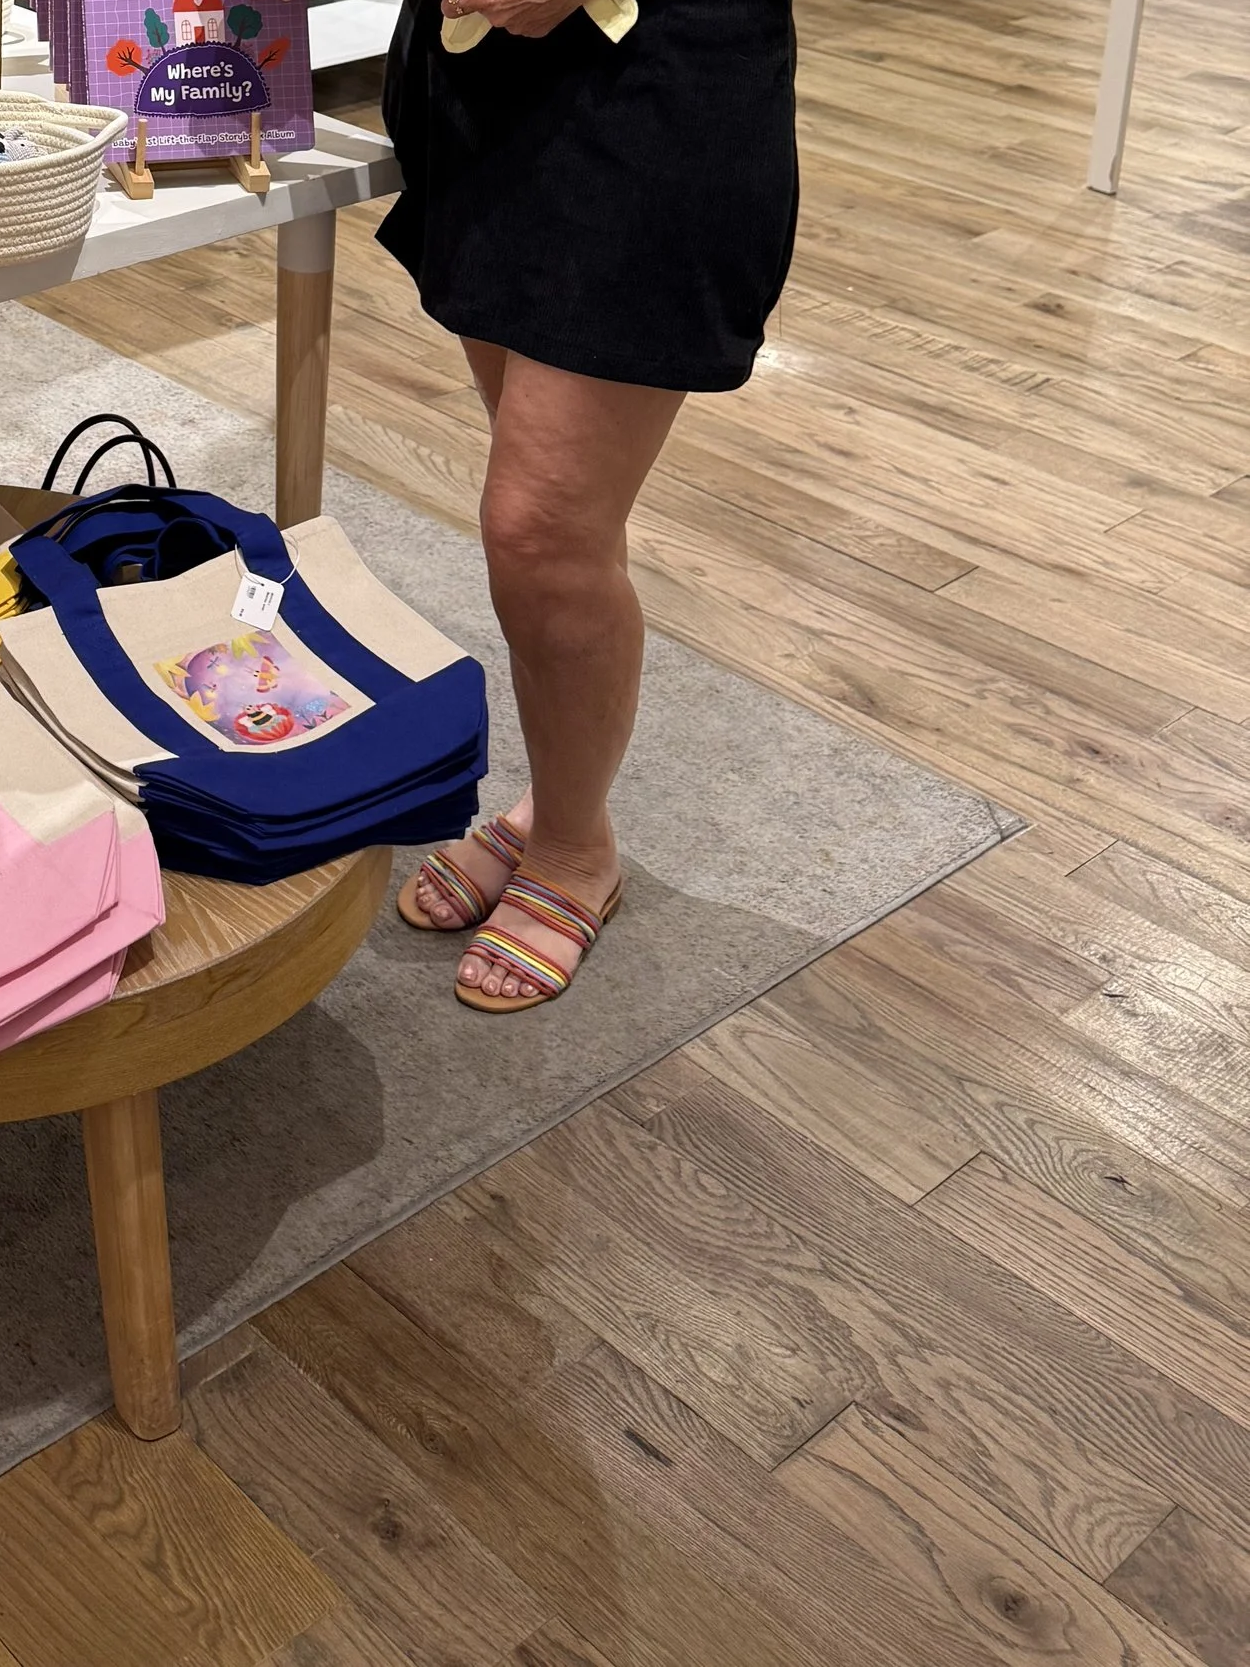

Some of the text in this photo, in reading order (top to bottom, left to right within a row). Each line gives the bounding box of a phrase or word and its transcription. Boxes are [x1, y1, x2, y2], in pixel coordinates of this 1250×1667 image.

[167, 61, 234, 80] Where's
[151, 80, 253, 106] My Family?
[113, 138, 137, 149] Baby'
[219, 131, 266, 144] Storybk
[267, 130, 295, 140] Album
